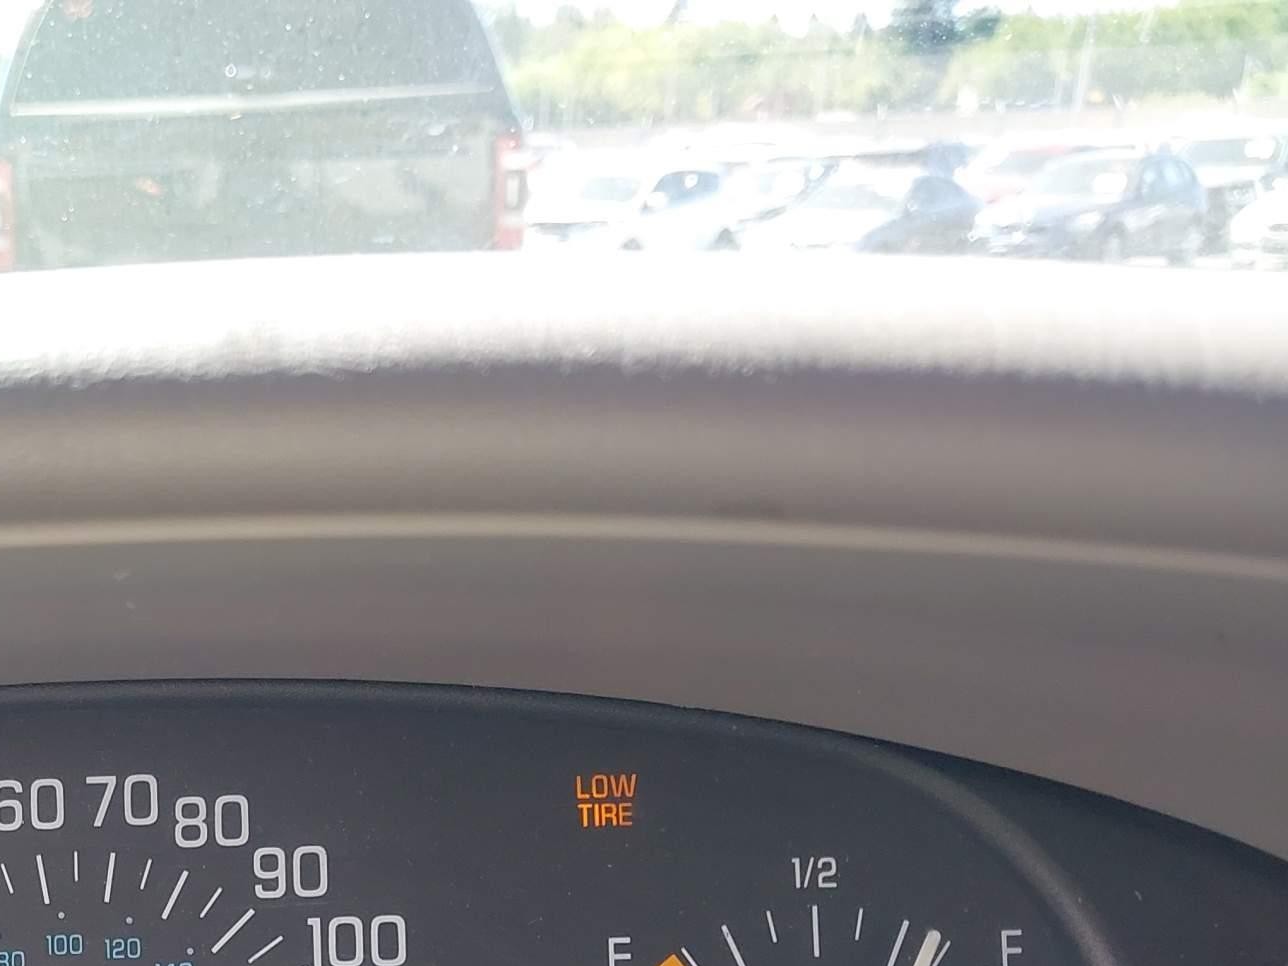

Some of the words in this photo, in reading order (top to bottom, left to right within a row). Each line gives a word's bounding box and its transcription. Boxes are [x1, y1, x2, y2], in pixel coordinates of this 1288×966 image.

[86, 774, 158, 826] 70
[577, 774, 636, 799] LOW
[175, 795, 249, 847] 80
[578, 803, 632, 826] TIRE
[254, 846, 327, 898] 90
[791, 857, 837, 888] 1/2
[47, 935, 82, 955] 100
[105, 938, 140, 958] 120
